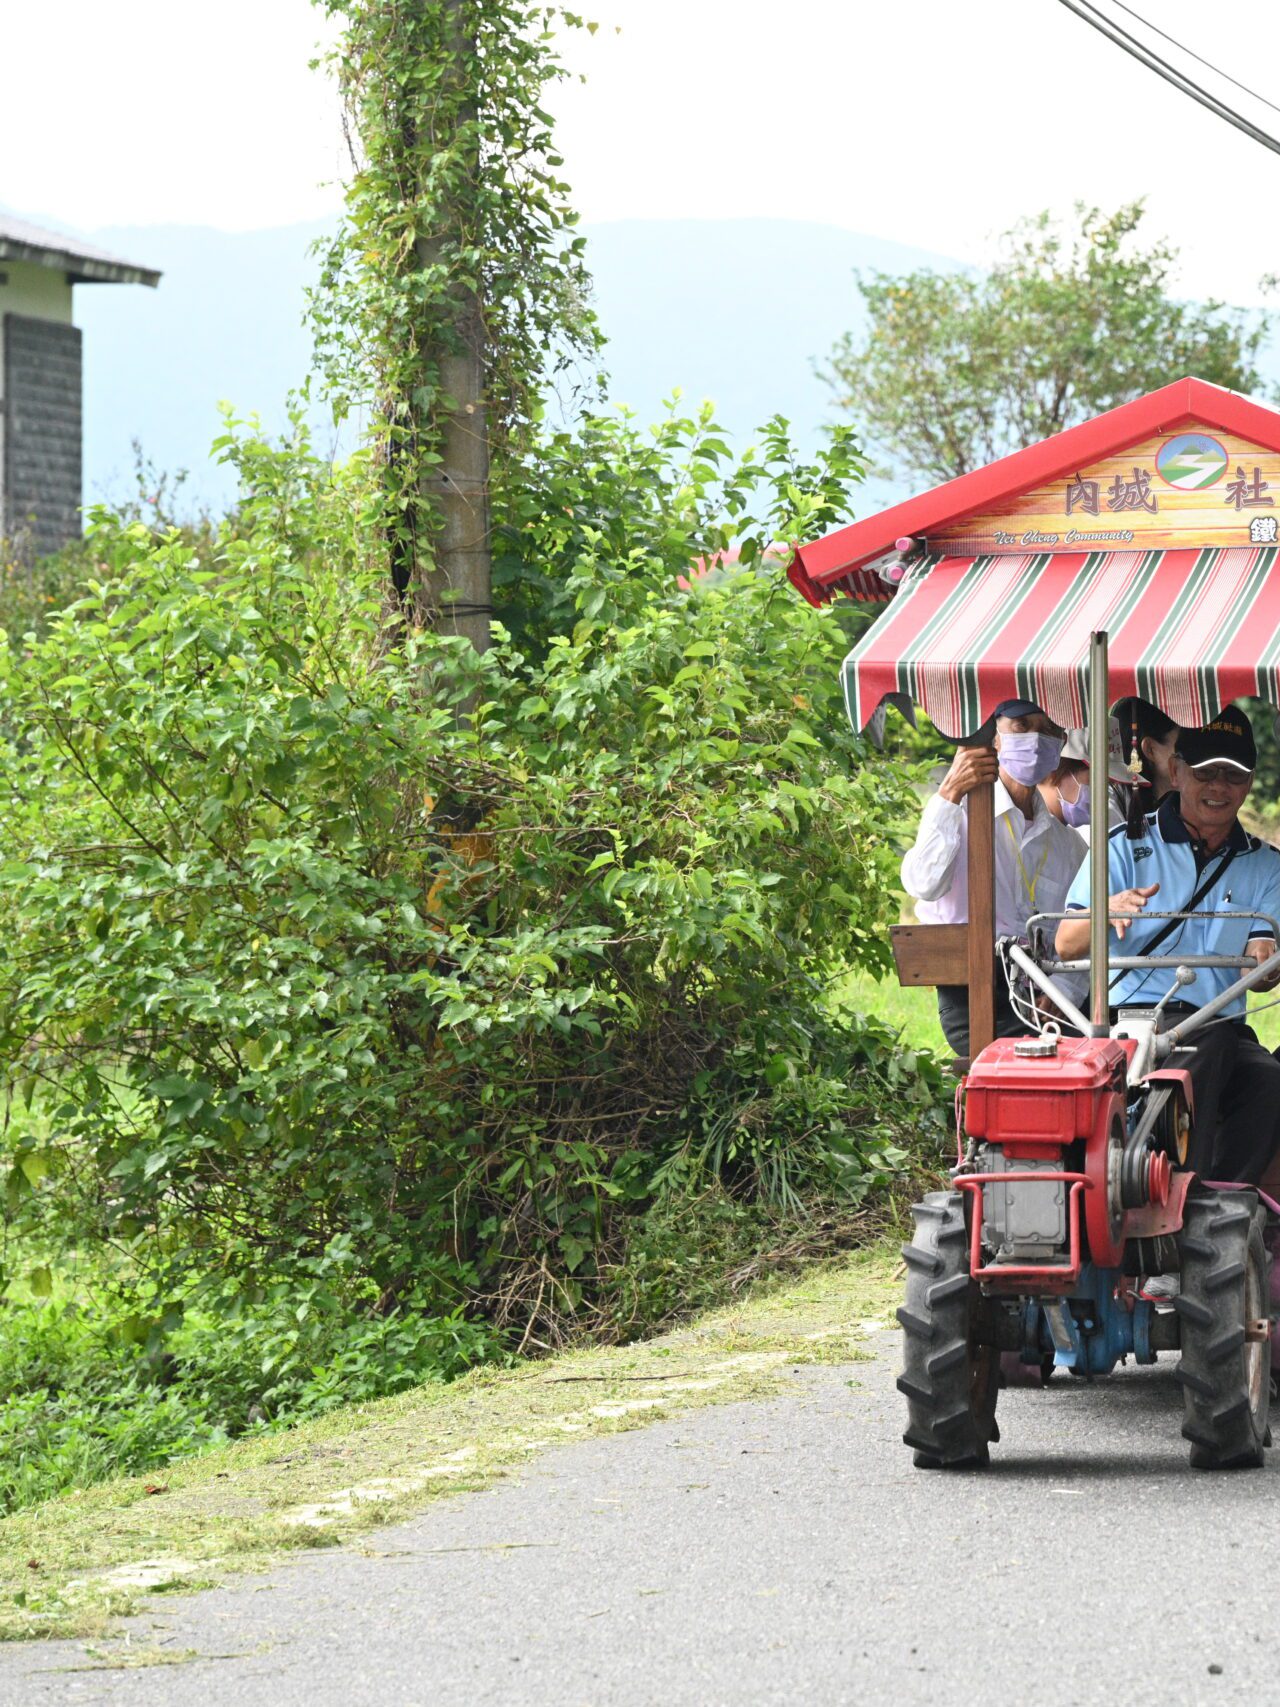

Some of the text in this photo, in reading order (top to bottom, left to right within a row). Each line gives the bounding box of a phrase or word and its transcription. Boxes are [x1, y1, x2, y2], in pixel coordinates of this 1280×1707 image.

[1065, 468, 1159, 516] 內城
[993, 528, 1134, 546] Nei Cheng Community
